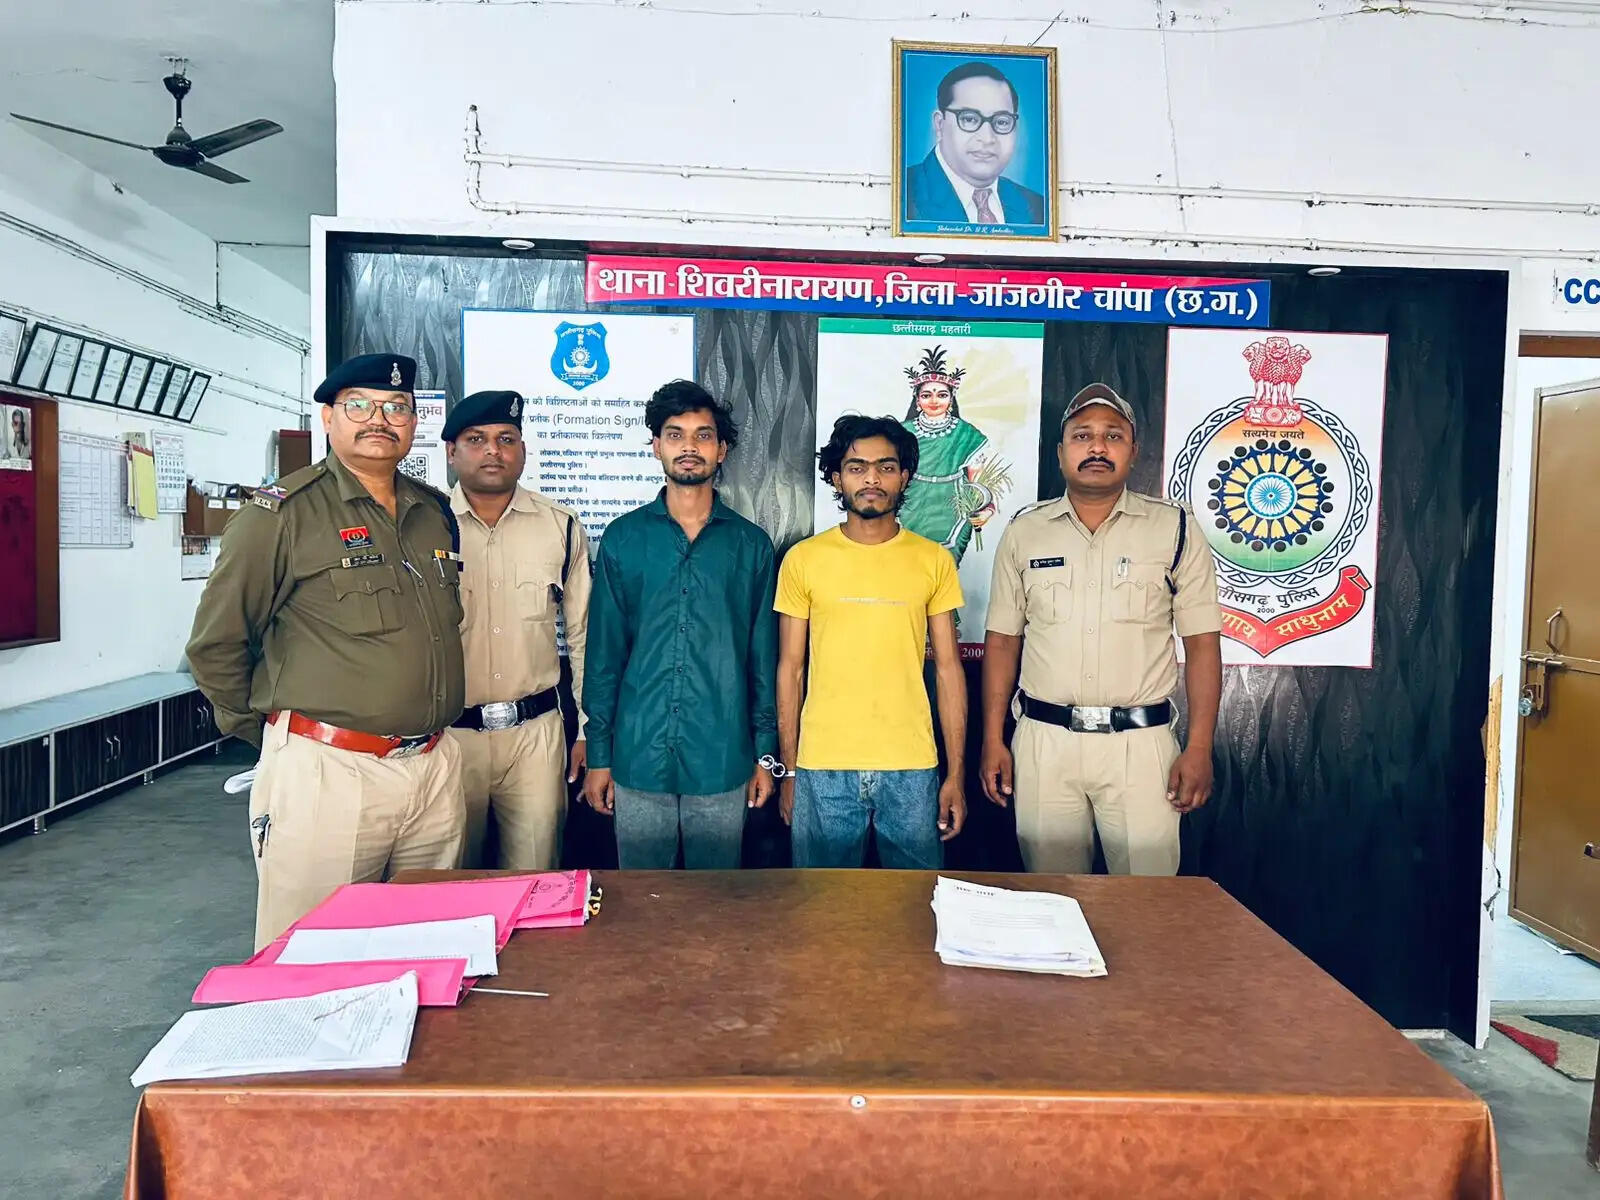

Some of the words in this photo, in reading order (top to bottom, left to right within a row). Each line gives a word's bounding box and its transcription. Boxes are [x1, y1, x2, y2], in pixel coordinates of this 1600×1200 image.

[1093, 282, 1153, 312] चांपा
[1164, 285, 1258, 320] (छ.ग.)
[941, 323, 971, 335] महतारी
[416, 406, 443, 420] नुभव
[553, 413, 610, 426] (Formation
[614, 414, 644, 428] Sign/I
[1242, 428, 1277, 438] सत्यमेव
[1280, 428, 1305, 439] जयते
[1218, 586, 1270, 607] त्तीसगढ़
[1276, 587, 1320, 608] पुलिस
